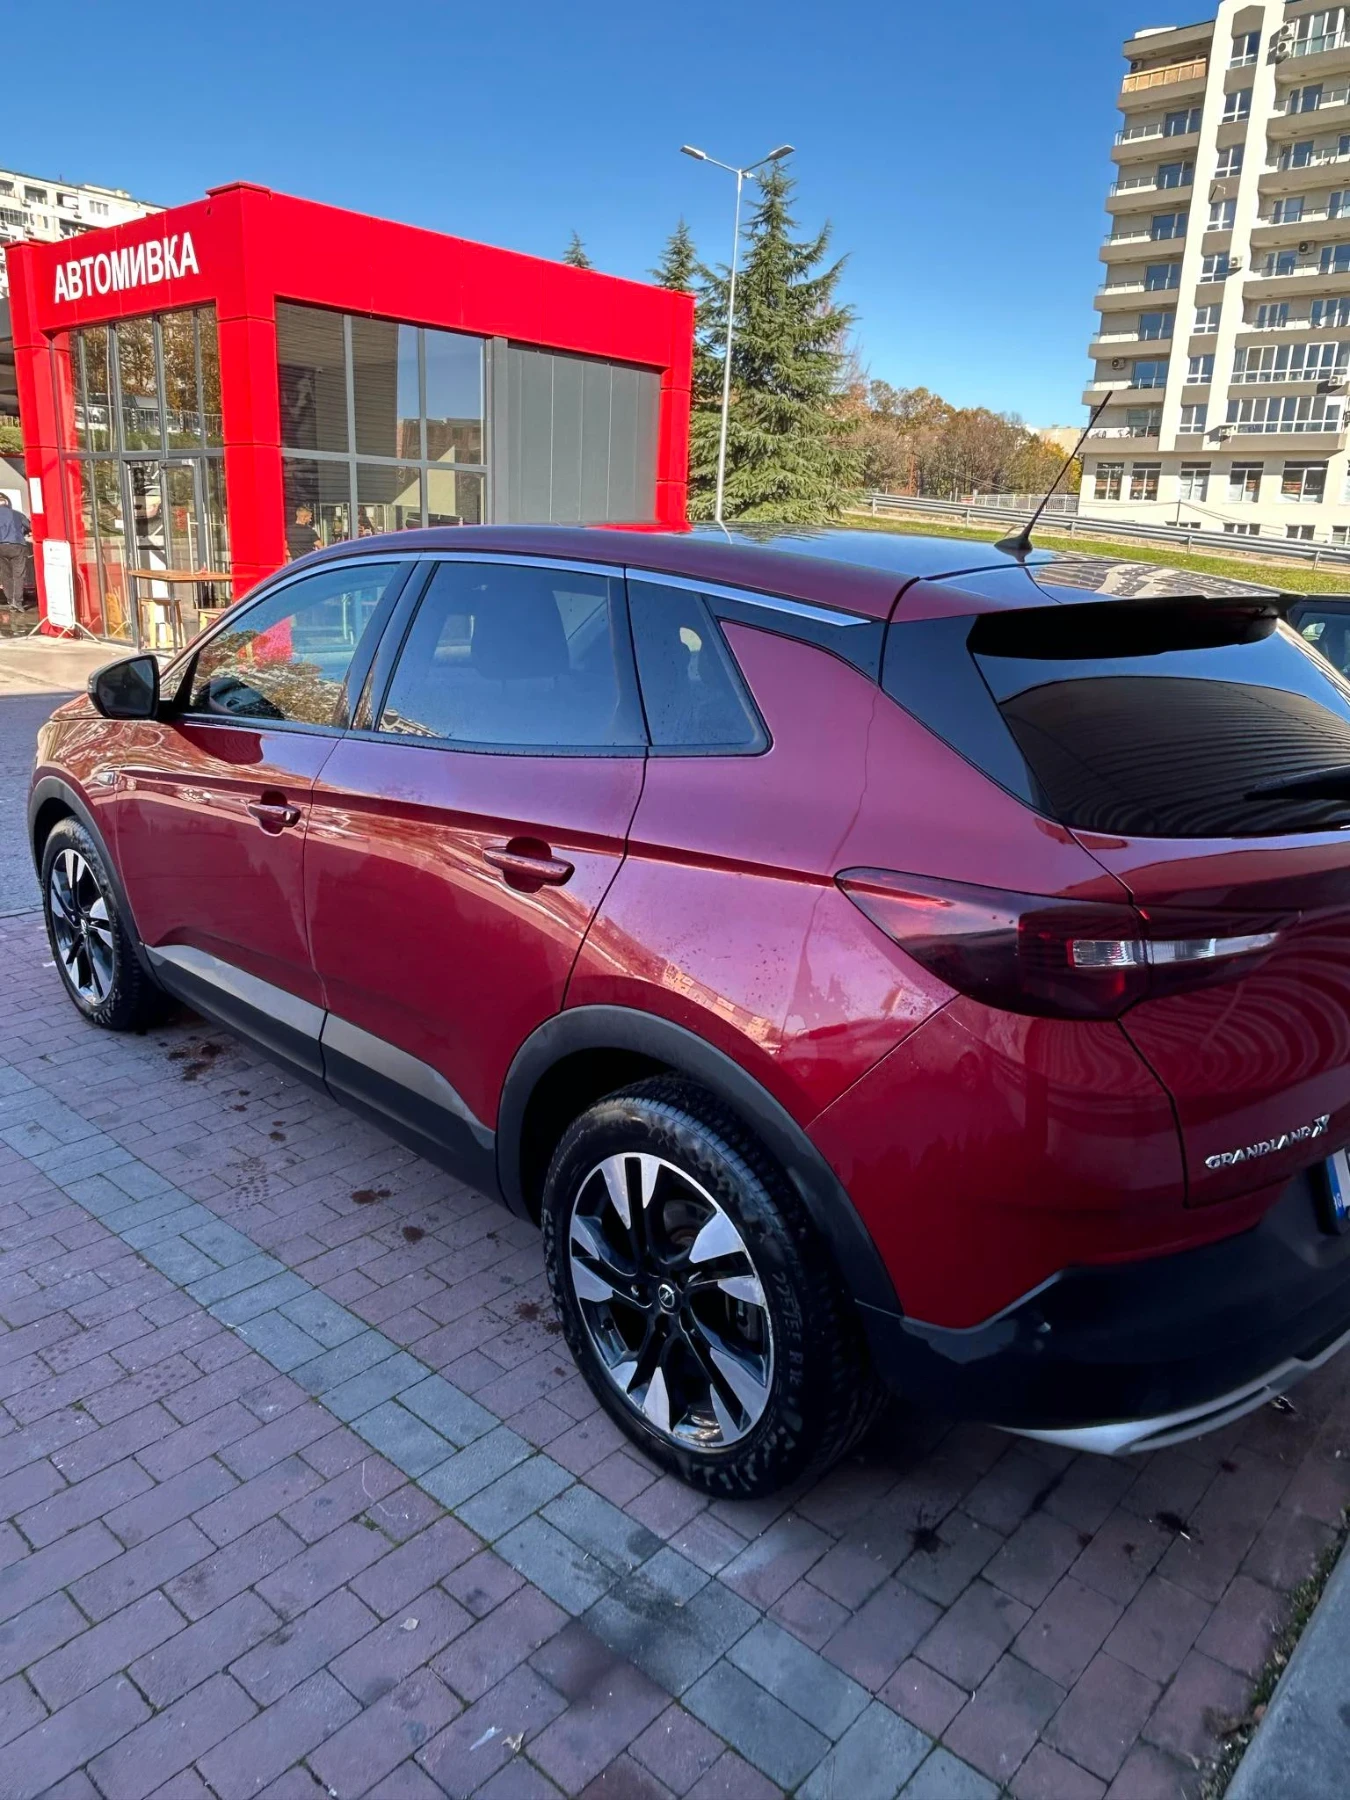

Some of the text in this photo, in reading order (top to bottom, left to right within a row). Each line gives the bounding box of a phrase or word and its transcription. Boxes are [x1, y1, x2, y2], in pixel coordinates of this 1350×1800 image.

[54, 231, 200, 304] АВТОМИВКА
[1205, 1113, 1331, 1169] GRANDLAND X
